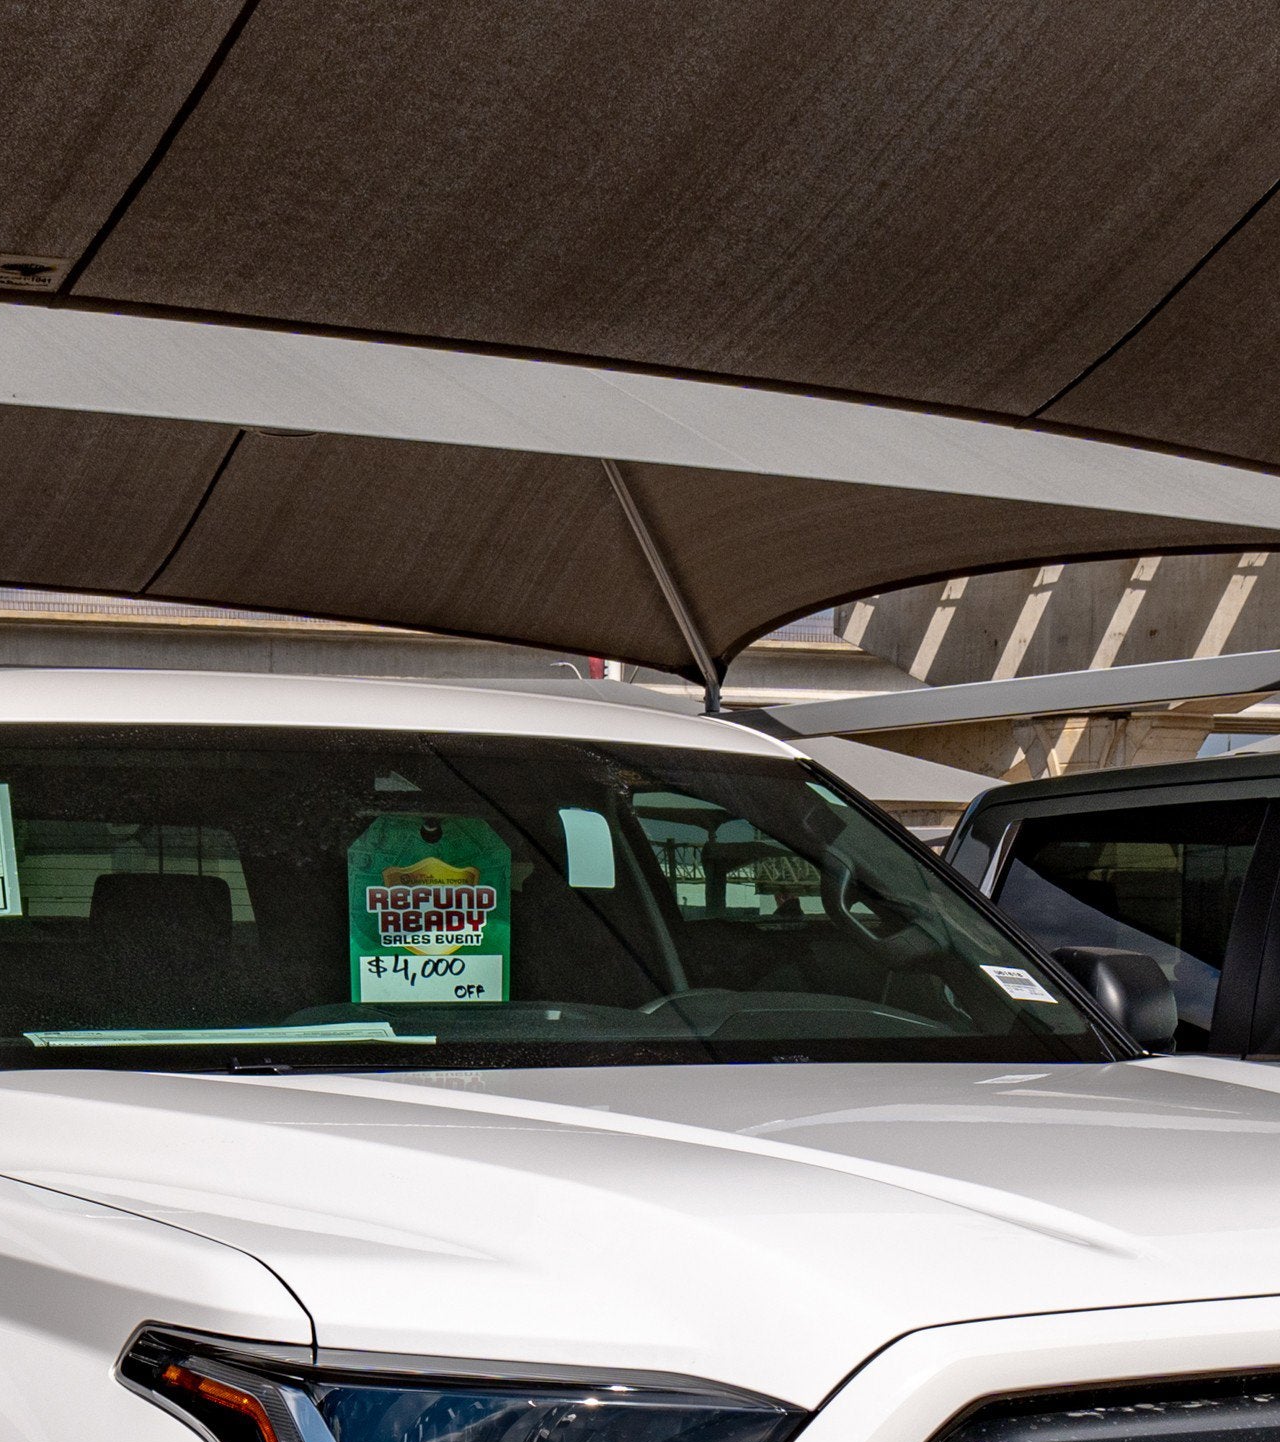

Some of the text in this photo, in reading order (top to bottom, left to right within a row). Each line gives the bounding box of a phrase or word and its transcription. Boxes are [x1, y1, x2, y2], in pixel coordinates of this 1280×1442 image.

[368, 887, 495, 911] REFUND
[380, 911, 486, 932] READY
[382, 934, 482, 945] SALES EVENT
[454, 985, 486, 999] OFF
